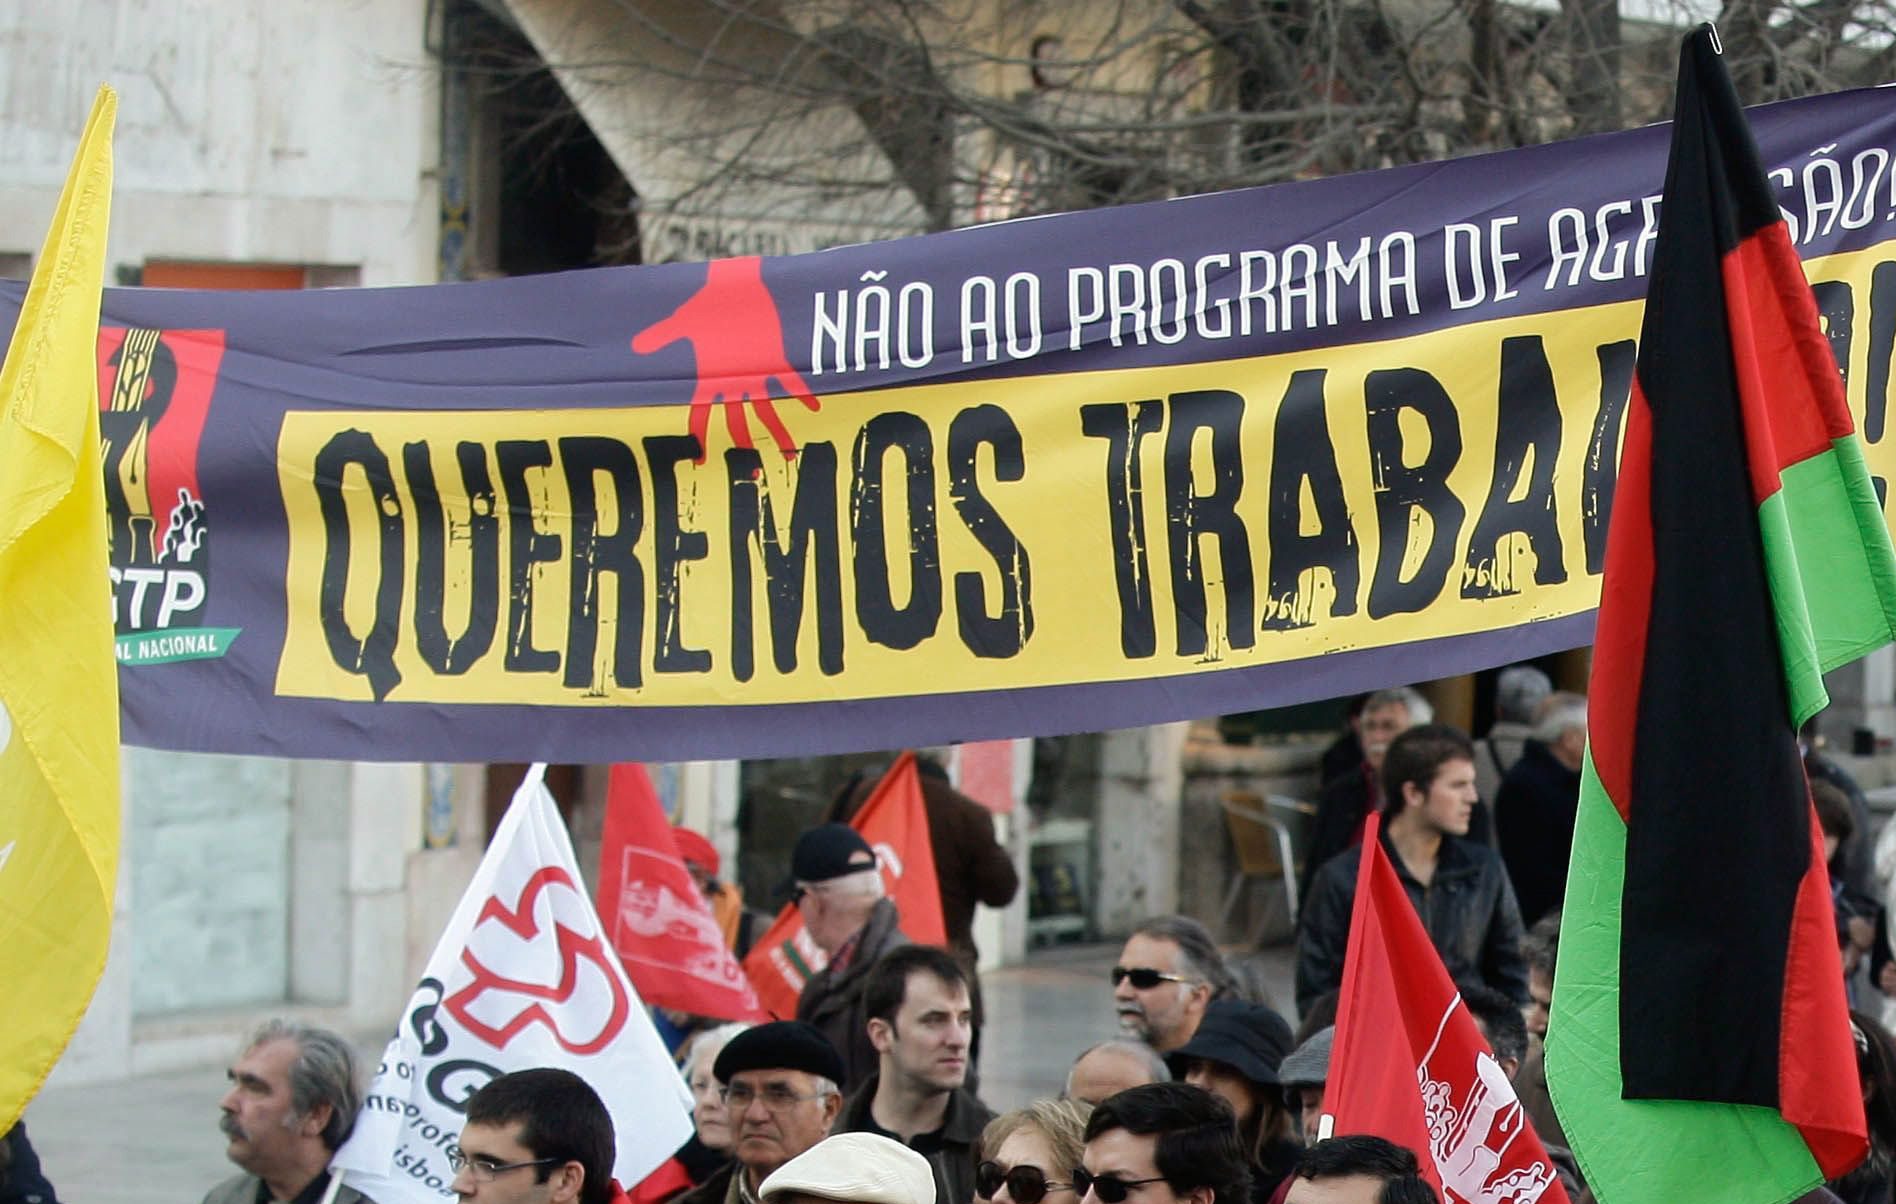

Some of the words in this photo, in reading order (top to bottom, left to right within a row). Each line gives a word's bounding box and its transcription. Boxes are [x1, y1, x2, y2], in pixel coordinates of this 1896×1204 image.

[810, 270, 934, 375] NÃO
[961, 272, 1041, 364] AO
[1069, 229, 1418, 350] PROGRAMA
[1444, 215, 1522, 311] DE
[313, 403, 1034, 702] QUEREMOS
[138, 634, 218, 659] NACIONAL
